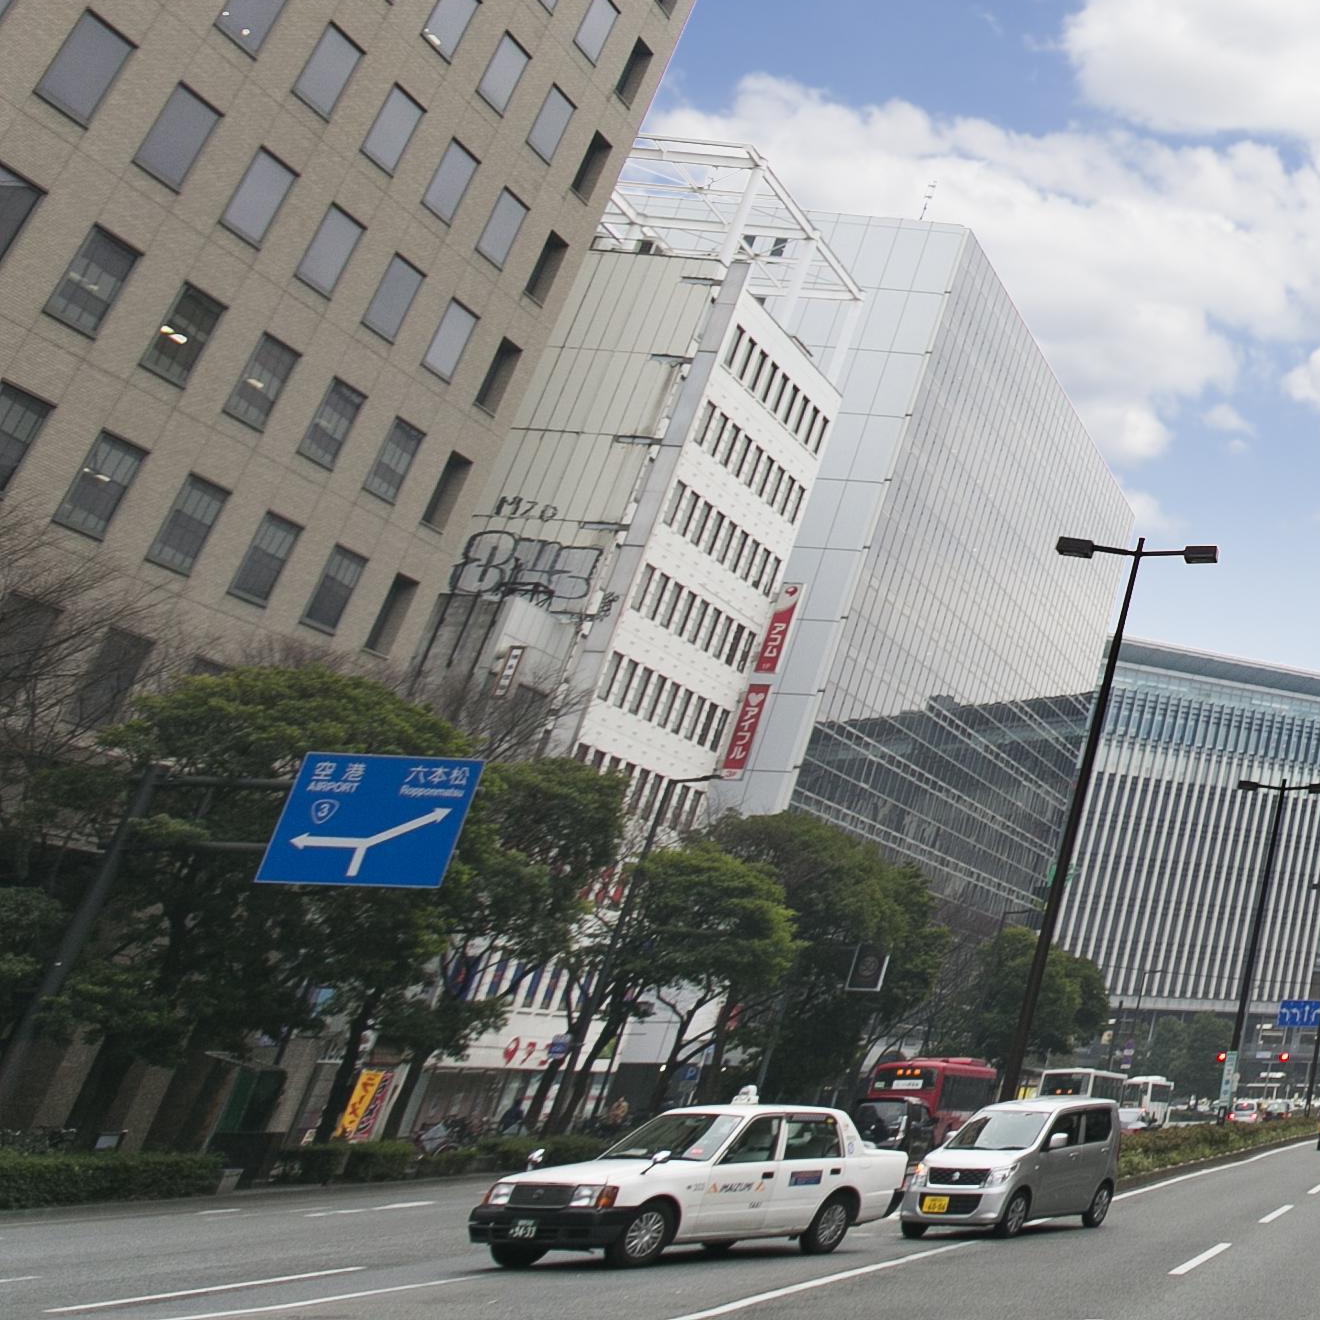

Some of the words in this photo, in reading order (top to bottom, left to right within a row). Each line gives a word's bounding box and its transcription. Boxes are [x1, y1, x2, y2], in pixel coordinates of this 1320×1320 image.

[763, 622, 786, 657] アコム
[729, 706, 757, 760] アイフル
[312, 760, 367, 782] 空港
[403, 765, 470, 786] 六本松
[306, 782, 359, 793] AIRPORT
[318, 802, 330, 817] 3
